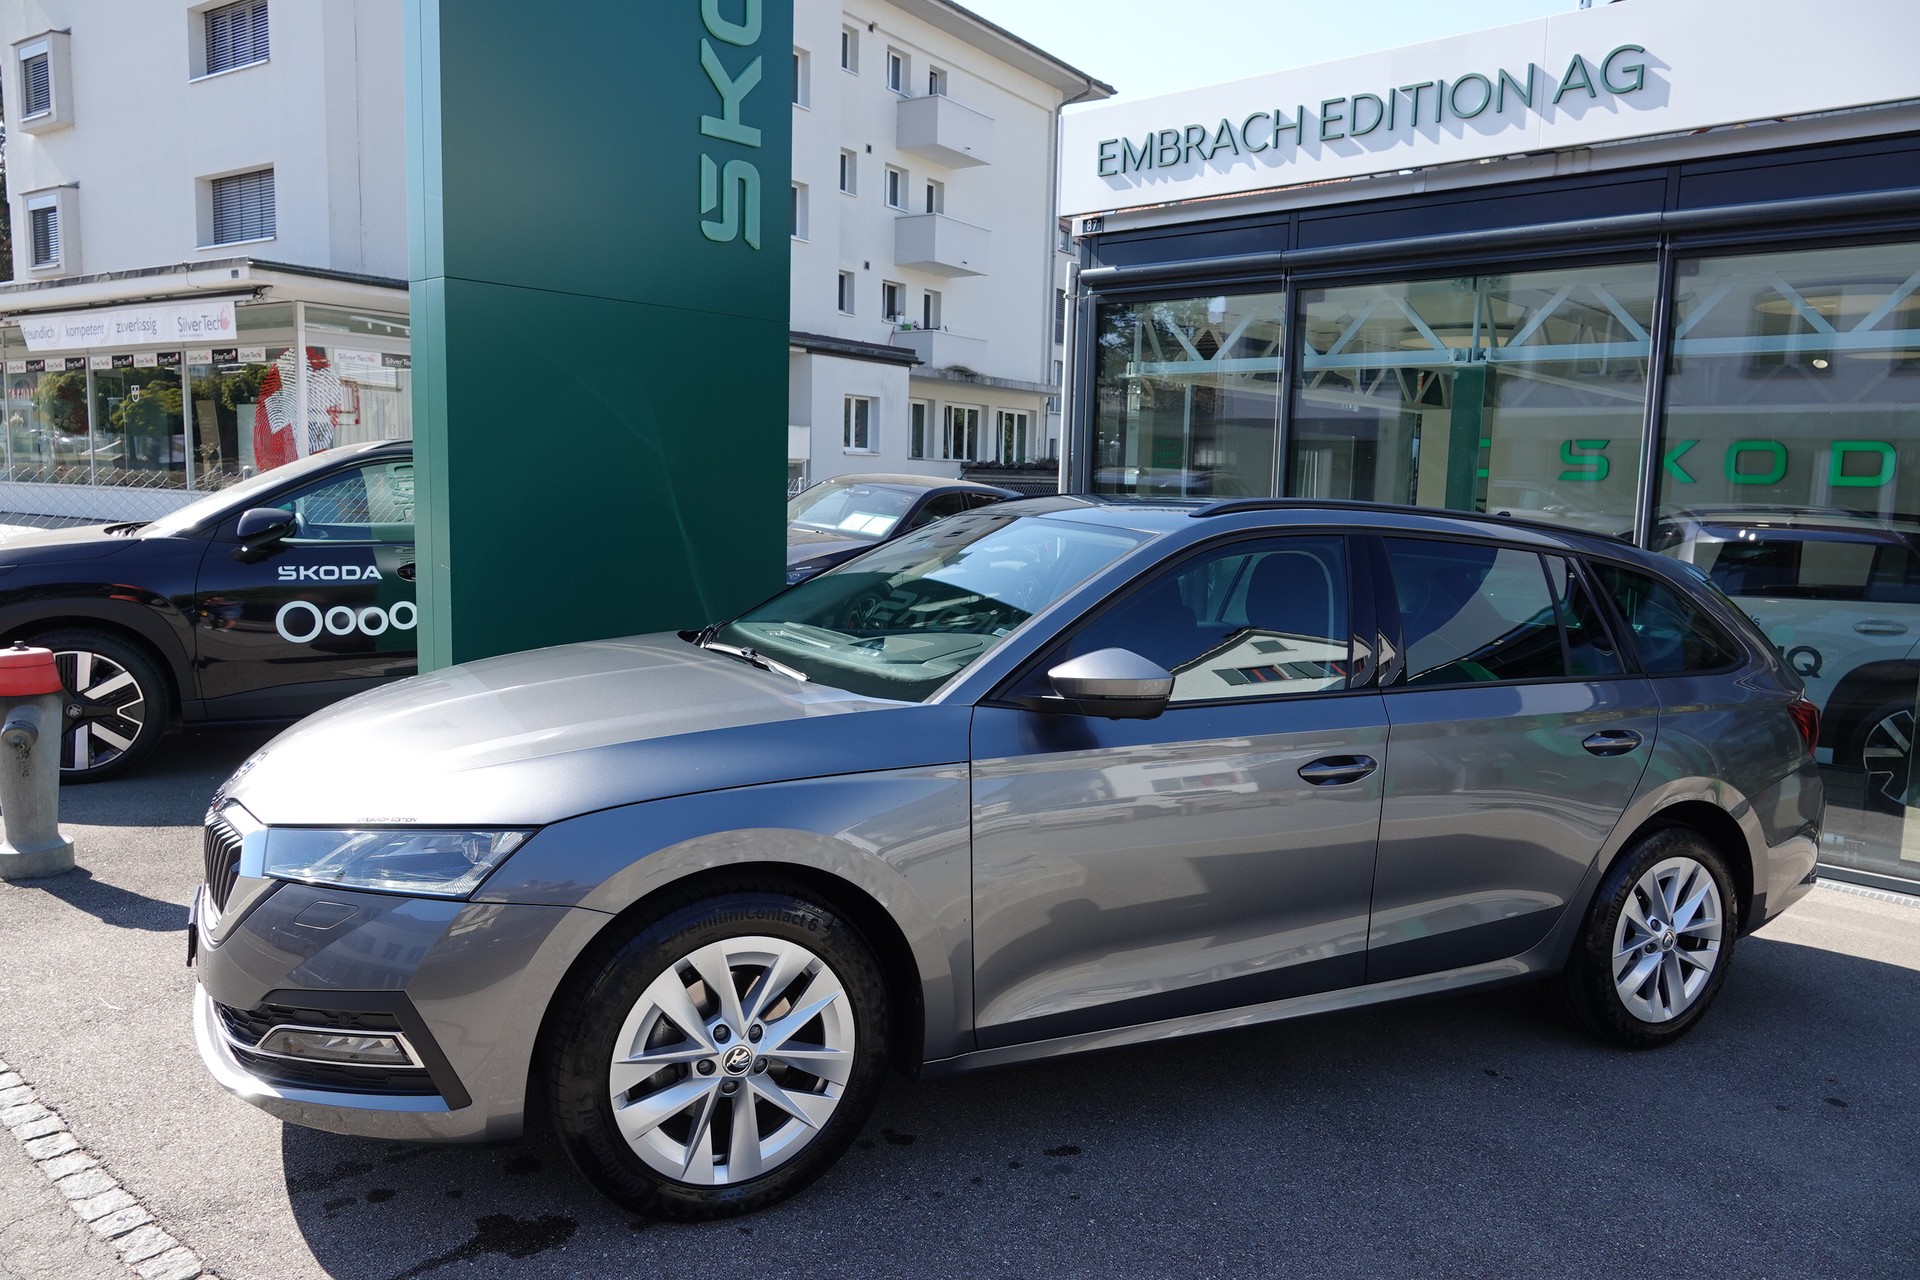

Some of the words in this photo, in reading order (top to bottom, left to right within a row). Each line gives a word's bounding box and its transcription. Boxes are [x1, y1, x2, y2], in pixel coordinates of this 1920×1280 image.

[1097, 104, 1303, 177] EMBRACH
[1319, 62, 1534, 142] EDITION
[1552, 44, 1645, 104] AG
[1086, 219, 1098, 232] 87
[177, 314, 222, 333] SilverTech
[277, 565, 383, 581] SKODA
